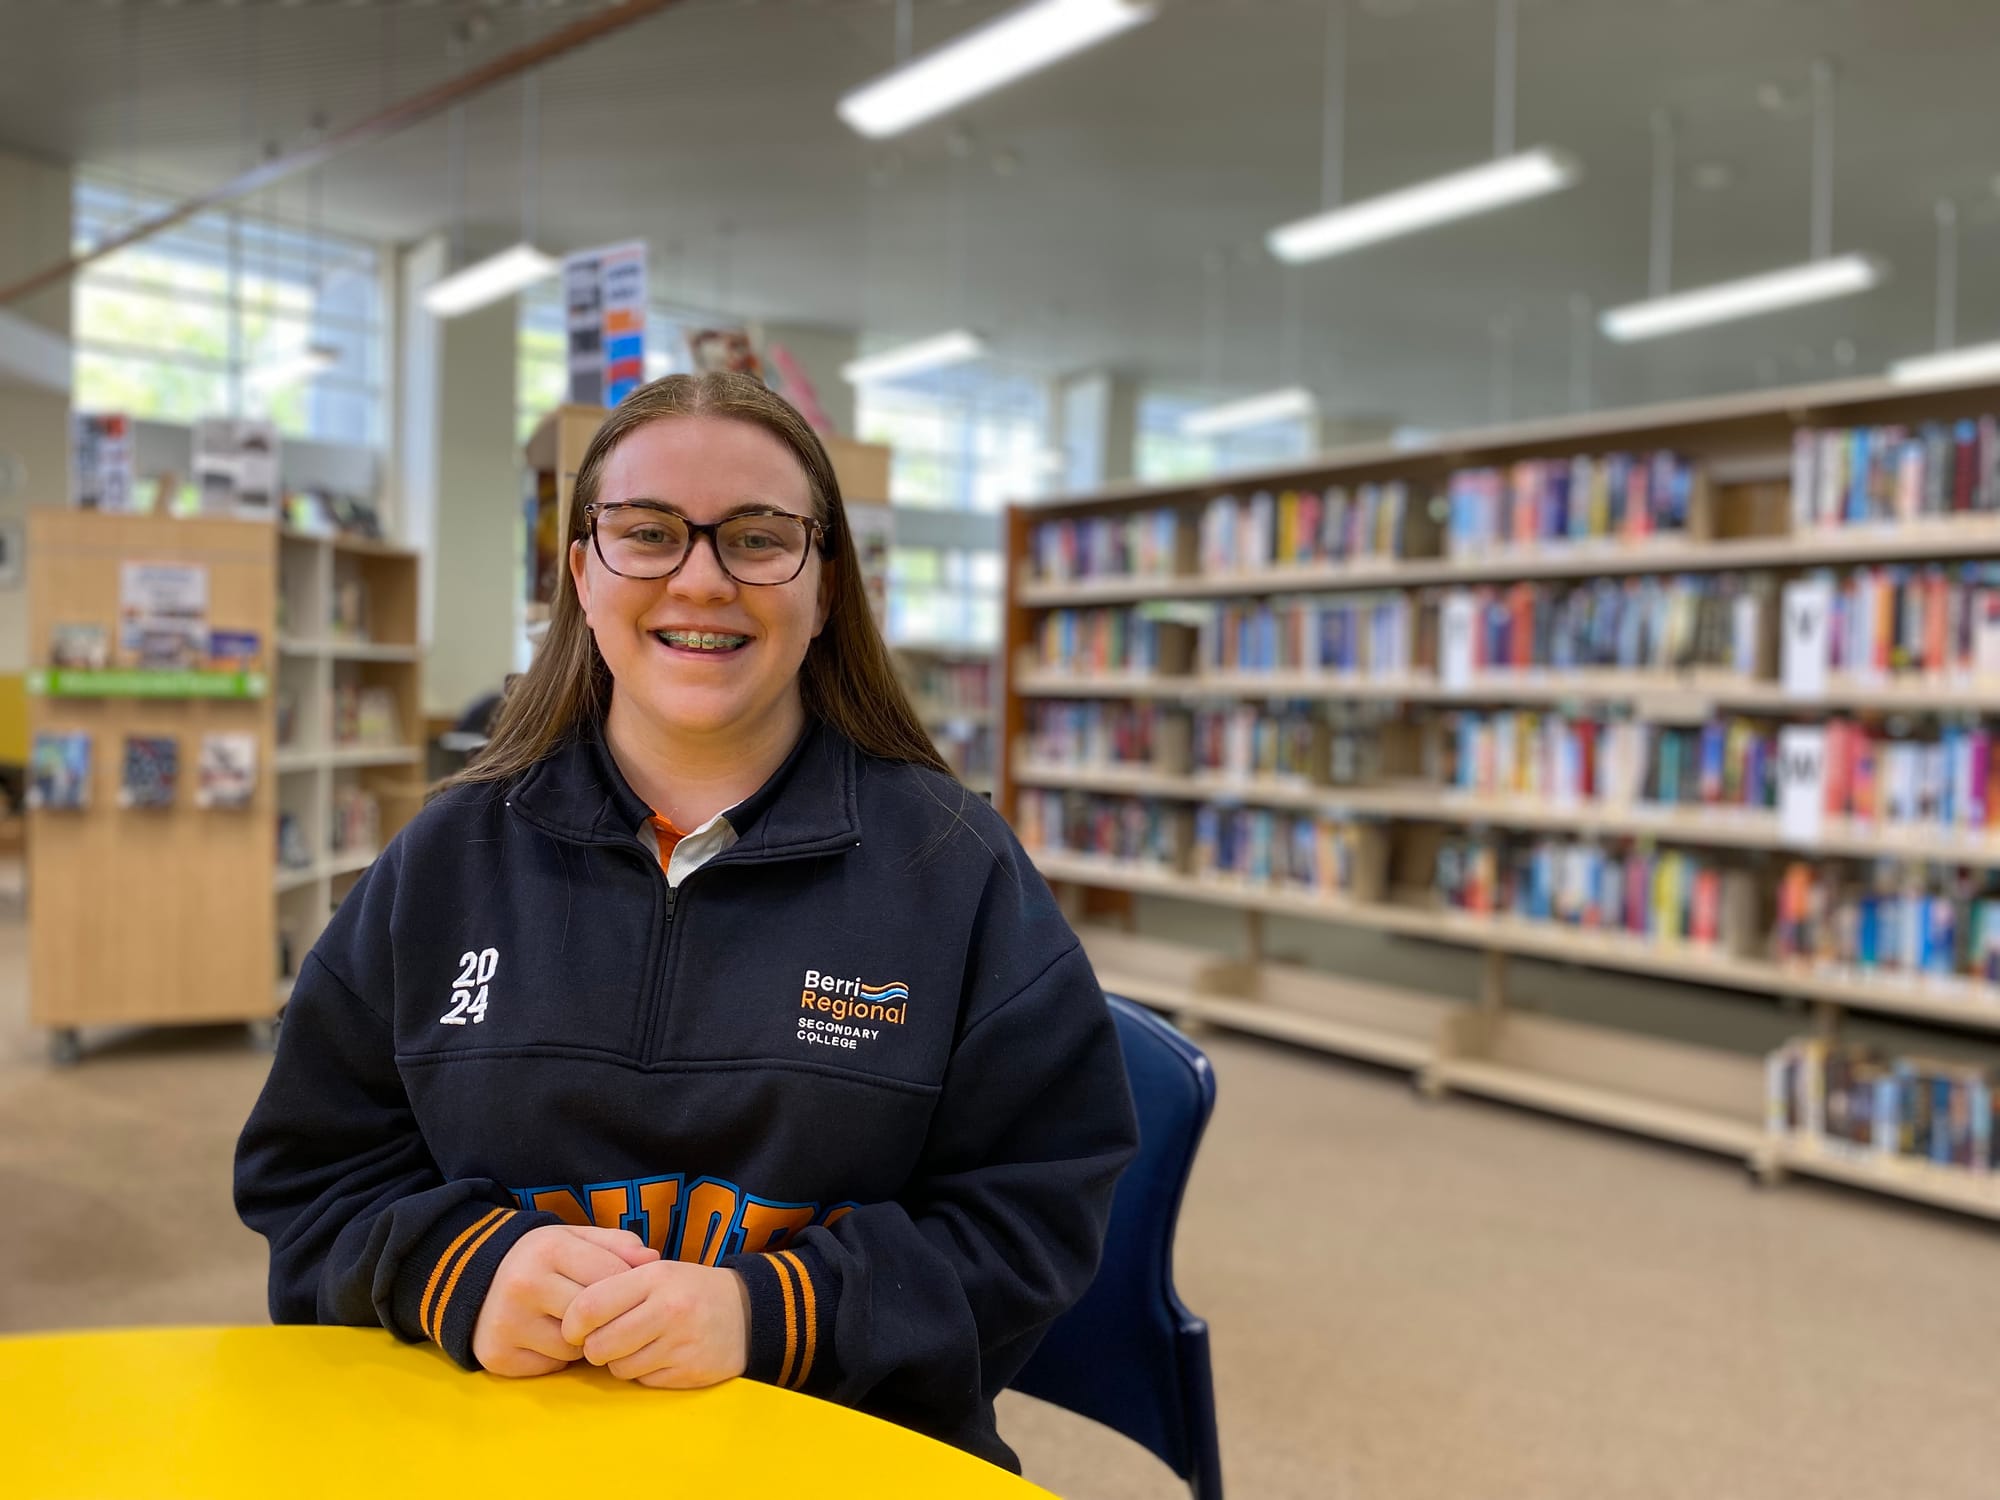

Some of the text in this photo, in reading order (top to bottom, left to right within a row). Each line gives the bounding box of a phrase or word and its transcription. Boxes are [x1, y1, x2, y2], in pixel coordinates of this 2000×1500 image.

[452, 947, 499, 988] 20
[804, 969, 861, 997] Berri
[439, 984, 488, 1025] 24
[801, 990, 907, 1025] Regional
[796, 1030, 857, 1050] COLLEGE
[798, 1017, 880, 1041] SECONDARY
